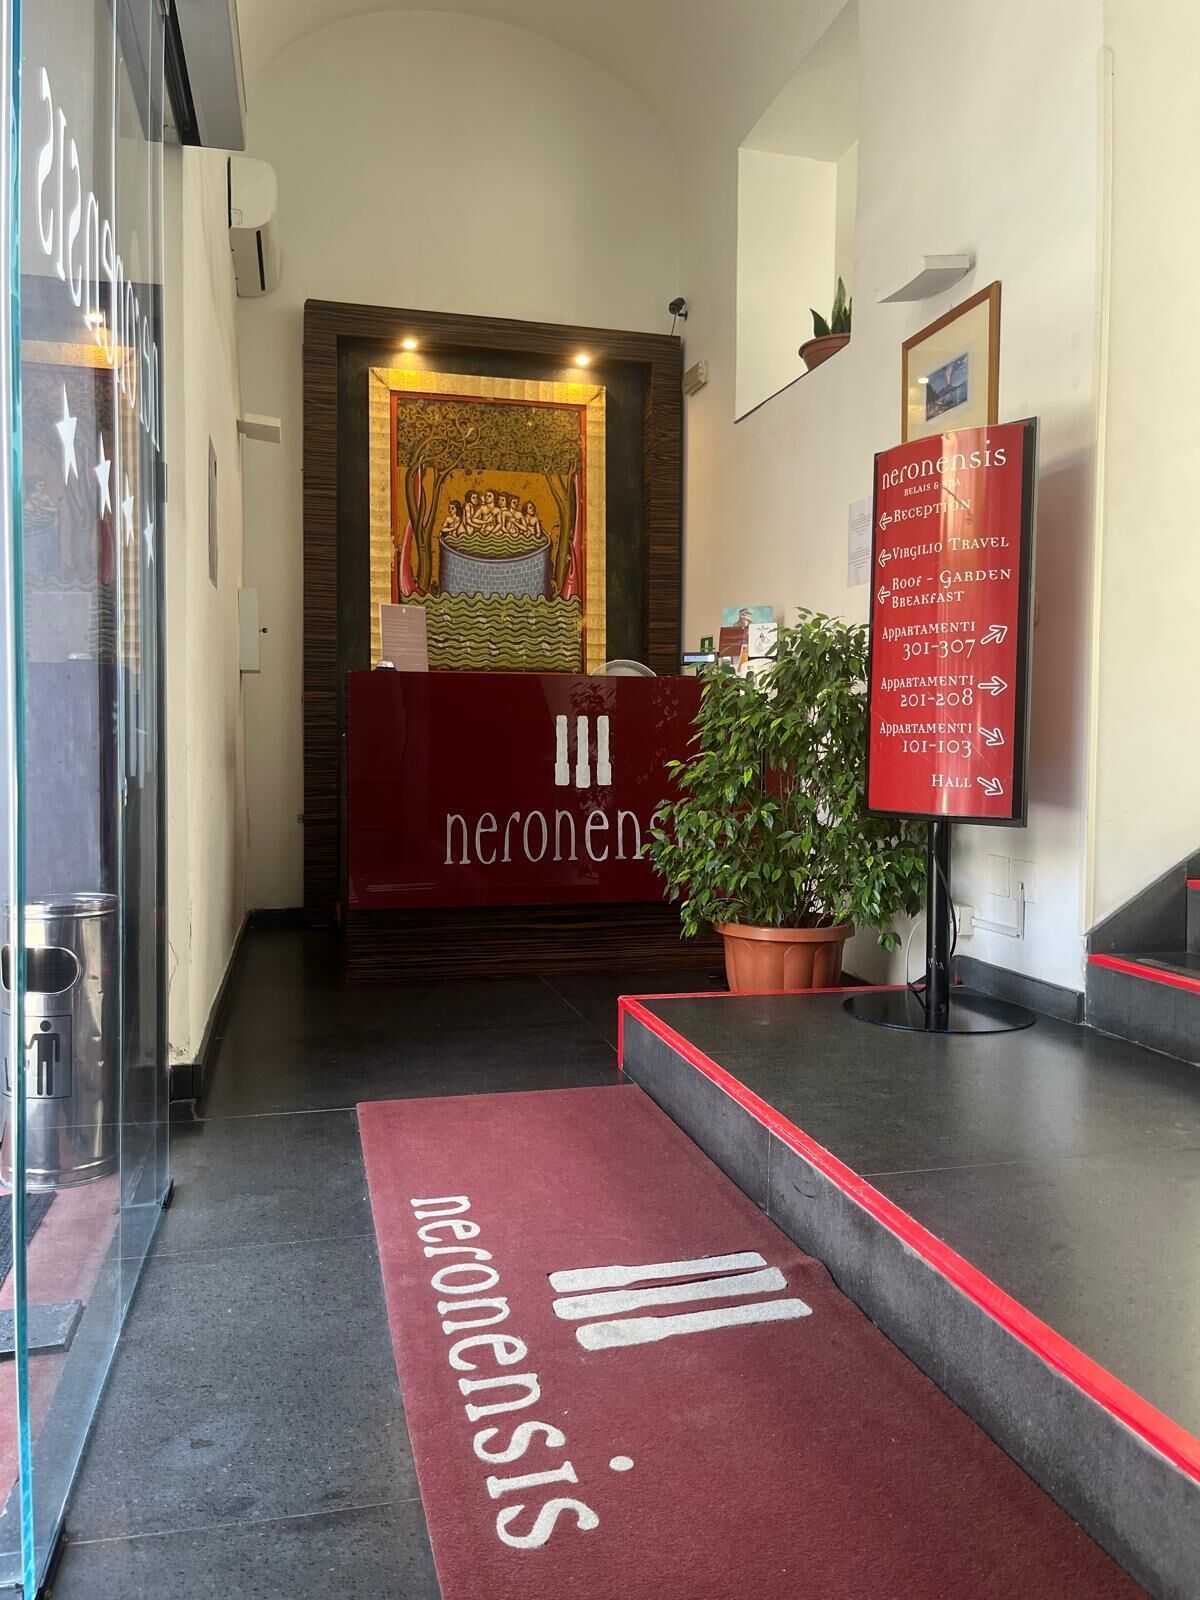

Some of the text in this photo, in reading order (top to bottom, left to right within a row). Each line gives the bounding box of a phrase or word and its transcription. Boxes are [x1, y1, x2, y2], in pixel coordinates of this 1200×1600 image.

[881, 439, 1007, 490] neronensis
[893, 499, 971, 523] RECEPTION
[892, 536, 1010, 560] VIRGILIO TRAVEL
[939, 568, 1011, 589] GARDEN
[892, 591, 965, 609] BREAKFAST
[882, 621, 976, 642] APPARTAMENTI
[903, 639, 976, 661] 301-307
[880, 675, 975, 692] APPARTAMENTI
[900, 687, 973, 708] 201-208
[879, 721, 973, 738] APPARTAMENTI
[903, 740, 972, 759] 101-103
[931, 774, 972, 788] HALL
[443, 808, 684, 865] neronen
[410, 1195, 635, 1550] neronensis
